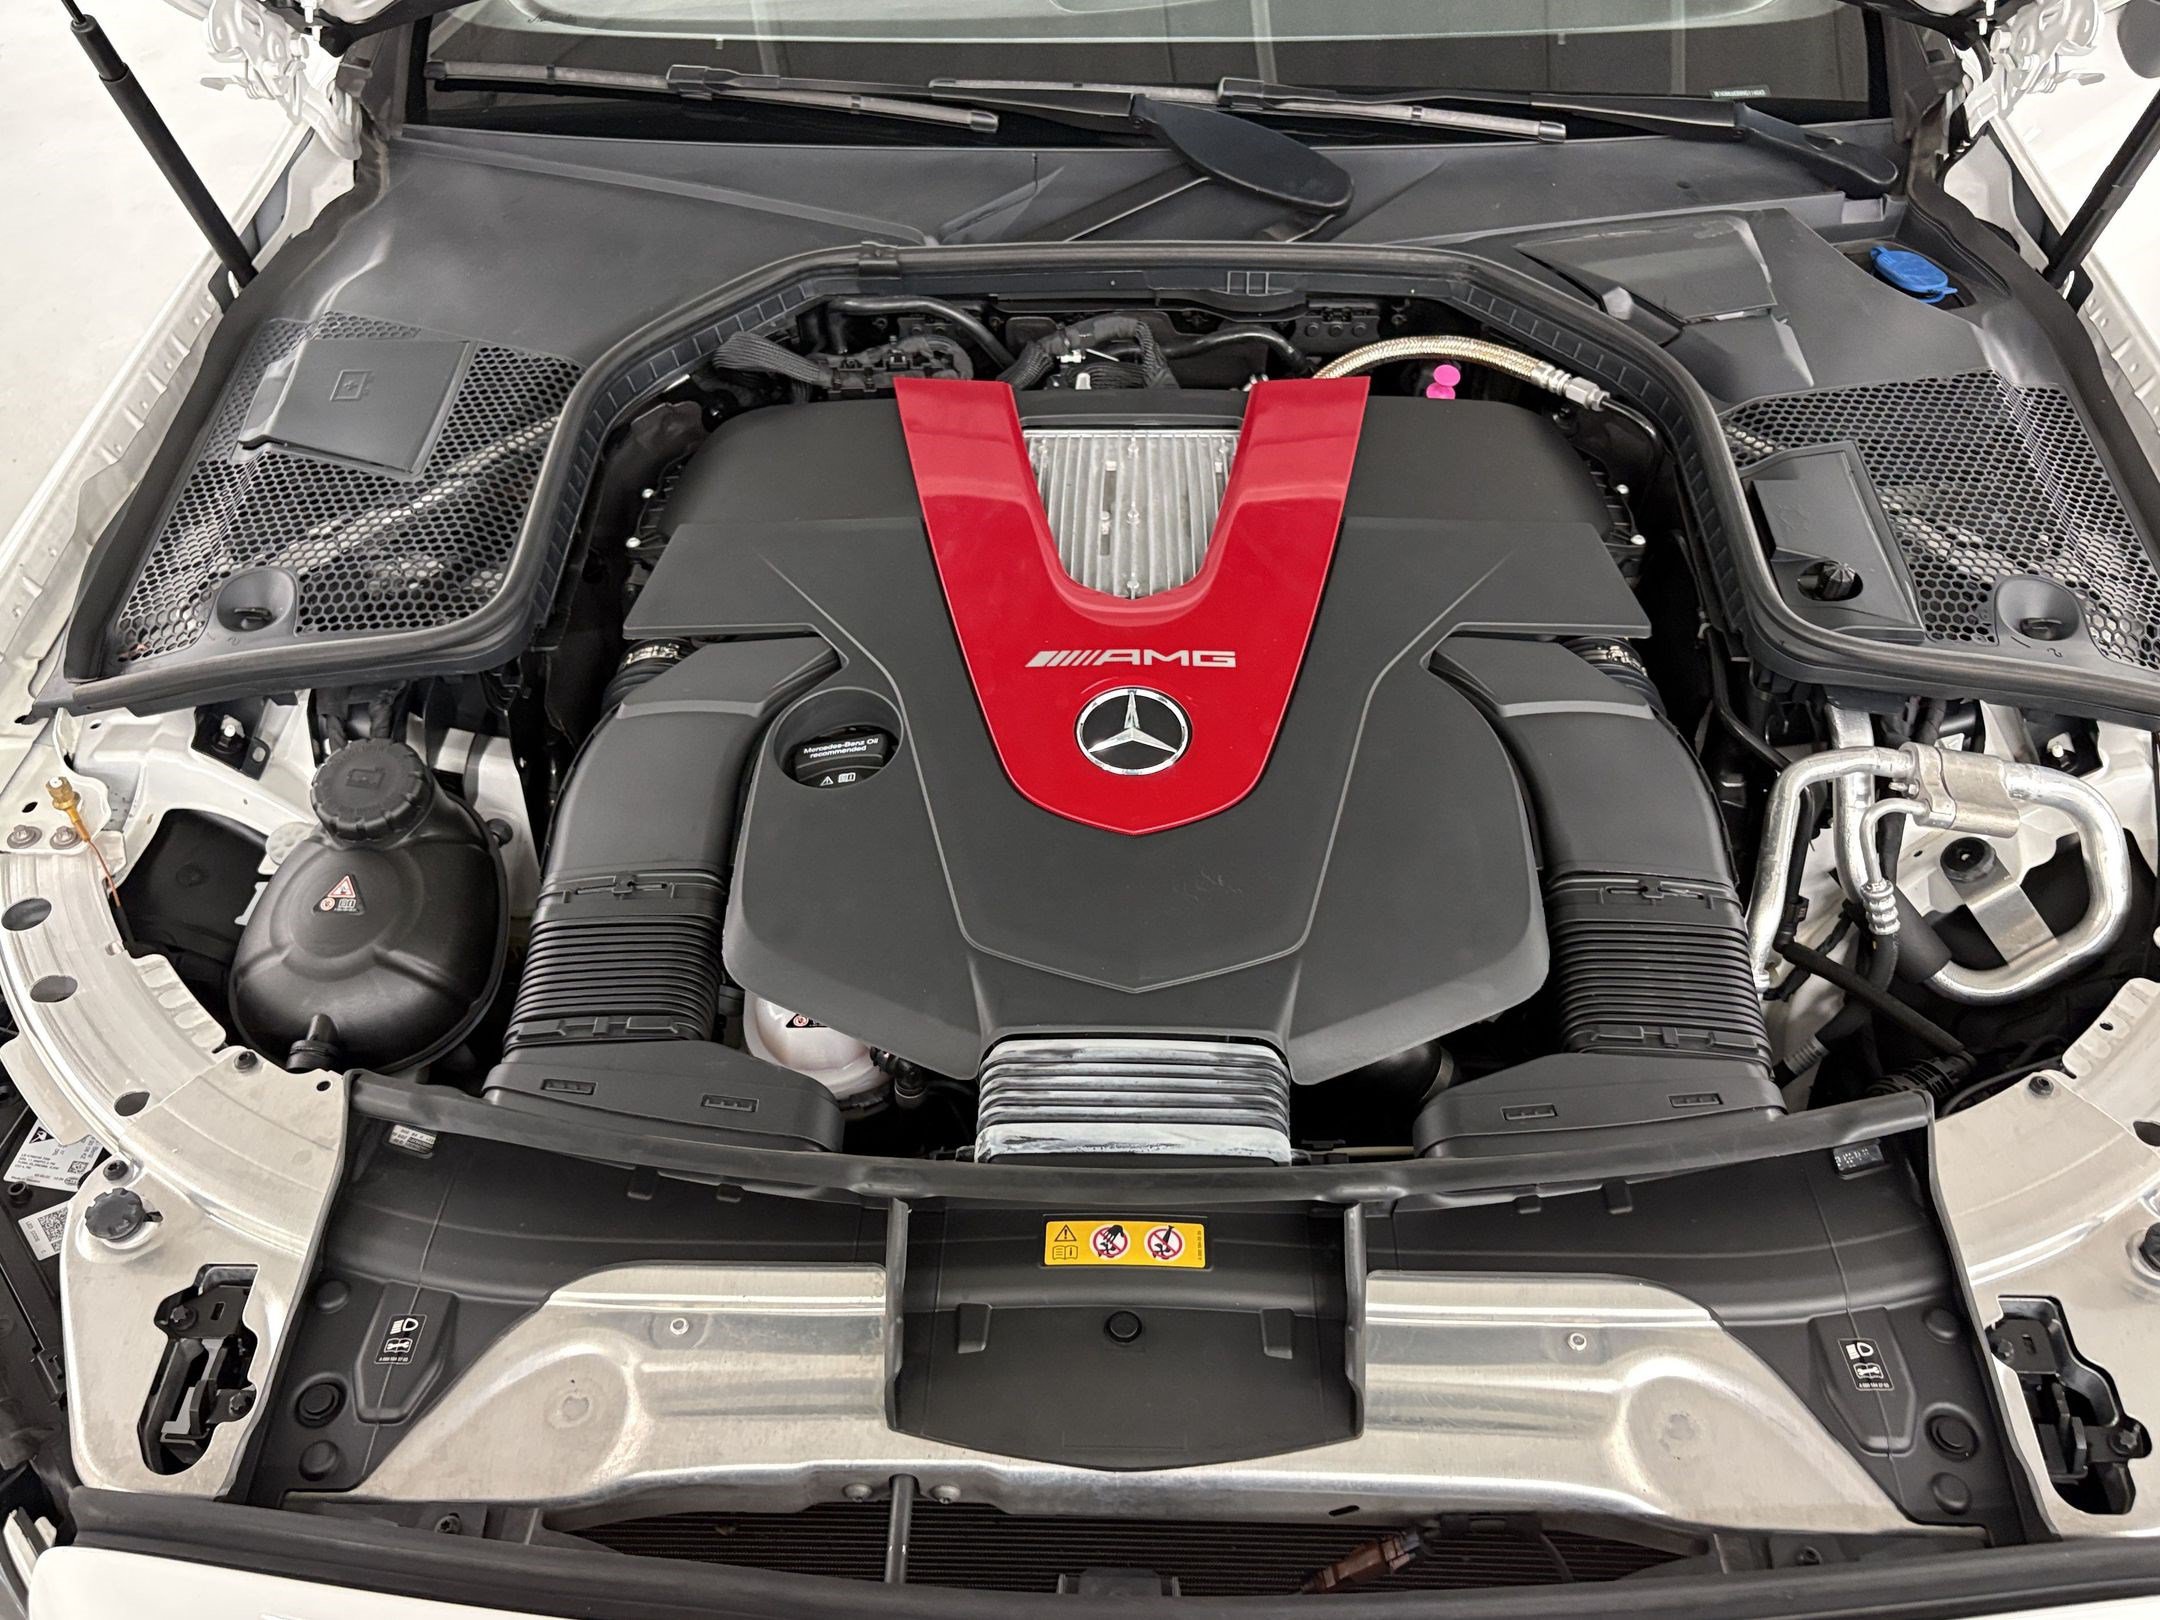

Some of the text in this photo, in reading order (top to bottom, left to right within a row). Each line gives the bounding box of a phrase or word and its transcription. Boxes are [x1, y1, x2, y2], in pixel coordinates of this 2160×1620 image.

[1093, 649, 1236, 668] AMG
[803, 741, 865, 753] Mercedes-Benz
[810, 746, 867, 758] recommended
